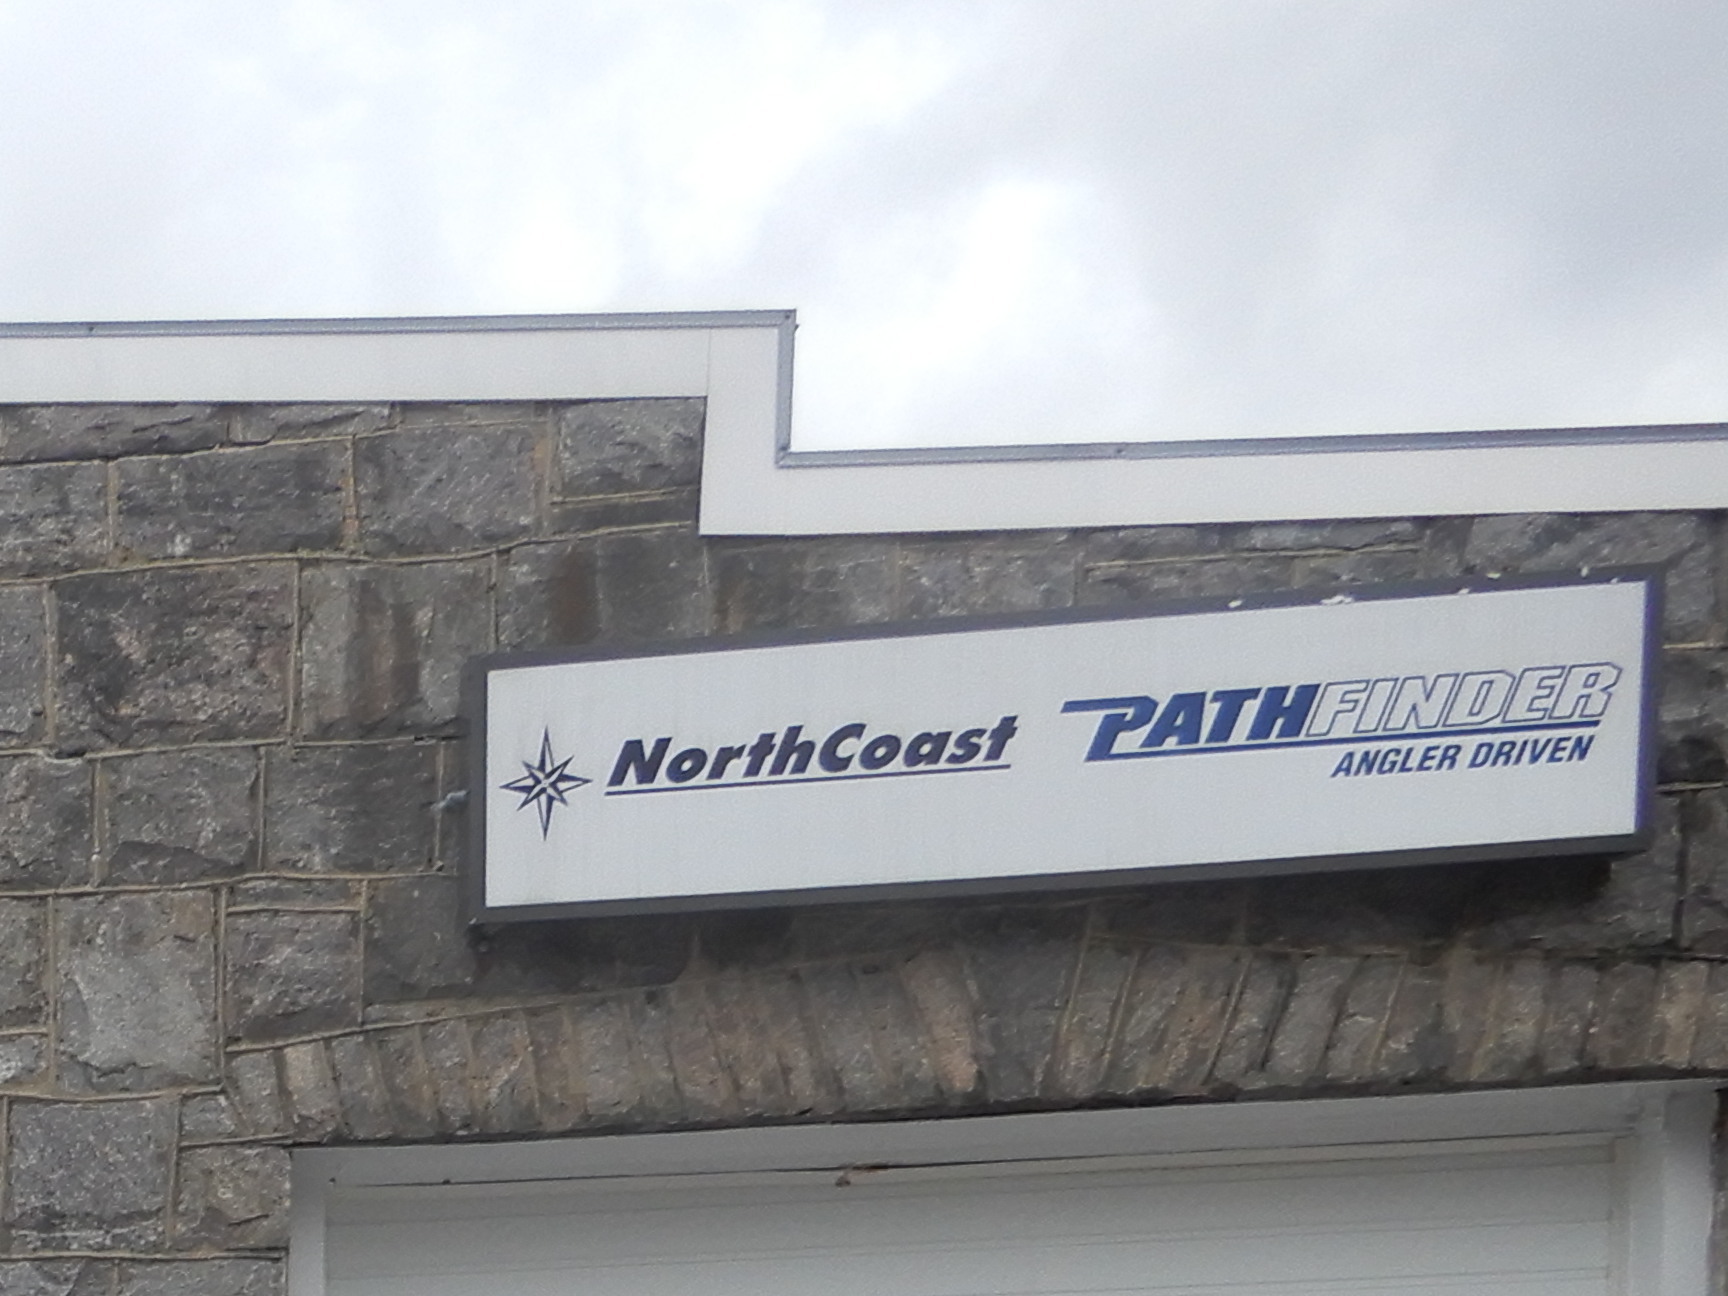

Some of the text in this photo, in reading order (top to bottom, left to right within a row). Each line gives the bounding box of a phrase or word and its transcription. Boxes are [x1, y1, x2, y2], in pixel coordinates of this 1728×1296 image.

[1060, 661, 1623, 763] PATHFINDER
[606, 714, 1019, 788] NorthCoast
[1330, 735, 1596, 778] ANGLER DRIVEN
